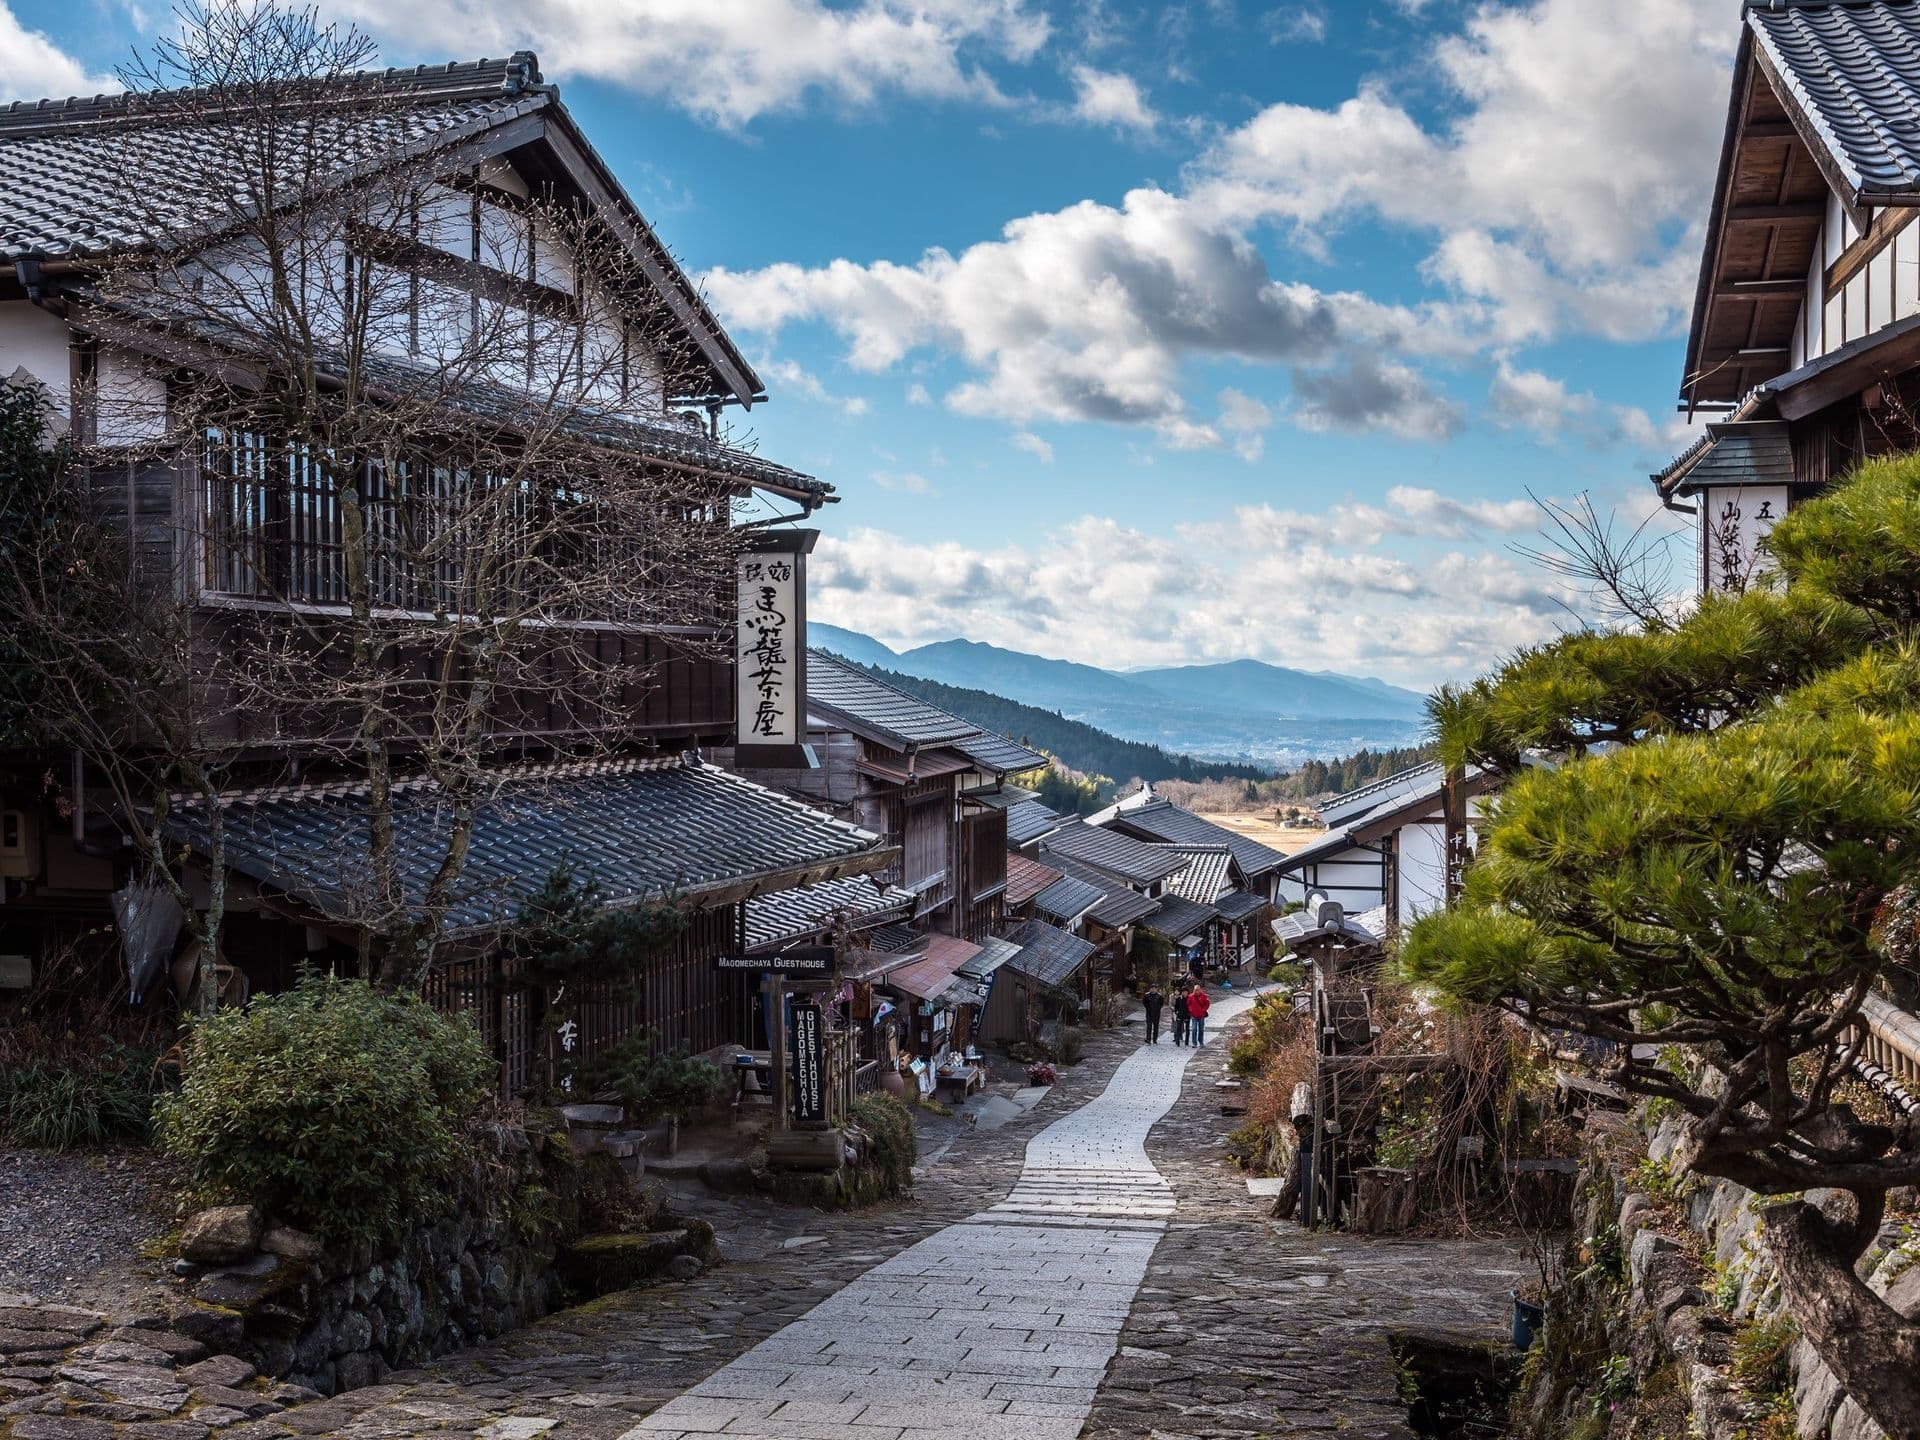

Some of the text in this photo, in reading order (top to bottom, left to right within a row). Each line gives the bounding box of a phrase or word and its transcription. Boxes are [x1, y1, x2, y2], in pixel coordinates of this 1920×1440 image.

[743, 586, 787, 737] 馬籠茶屋
[797, 1010, 809, 1117] MAGOMECHAYA
[806, 1010, 819, 1111] GUESTHOUSE
